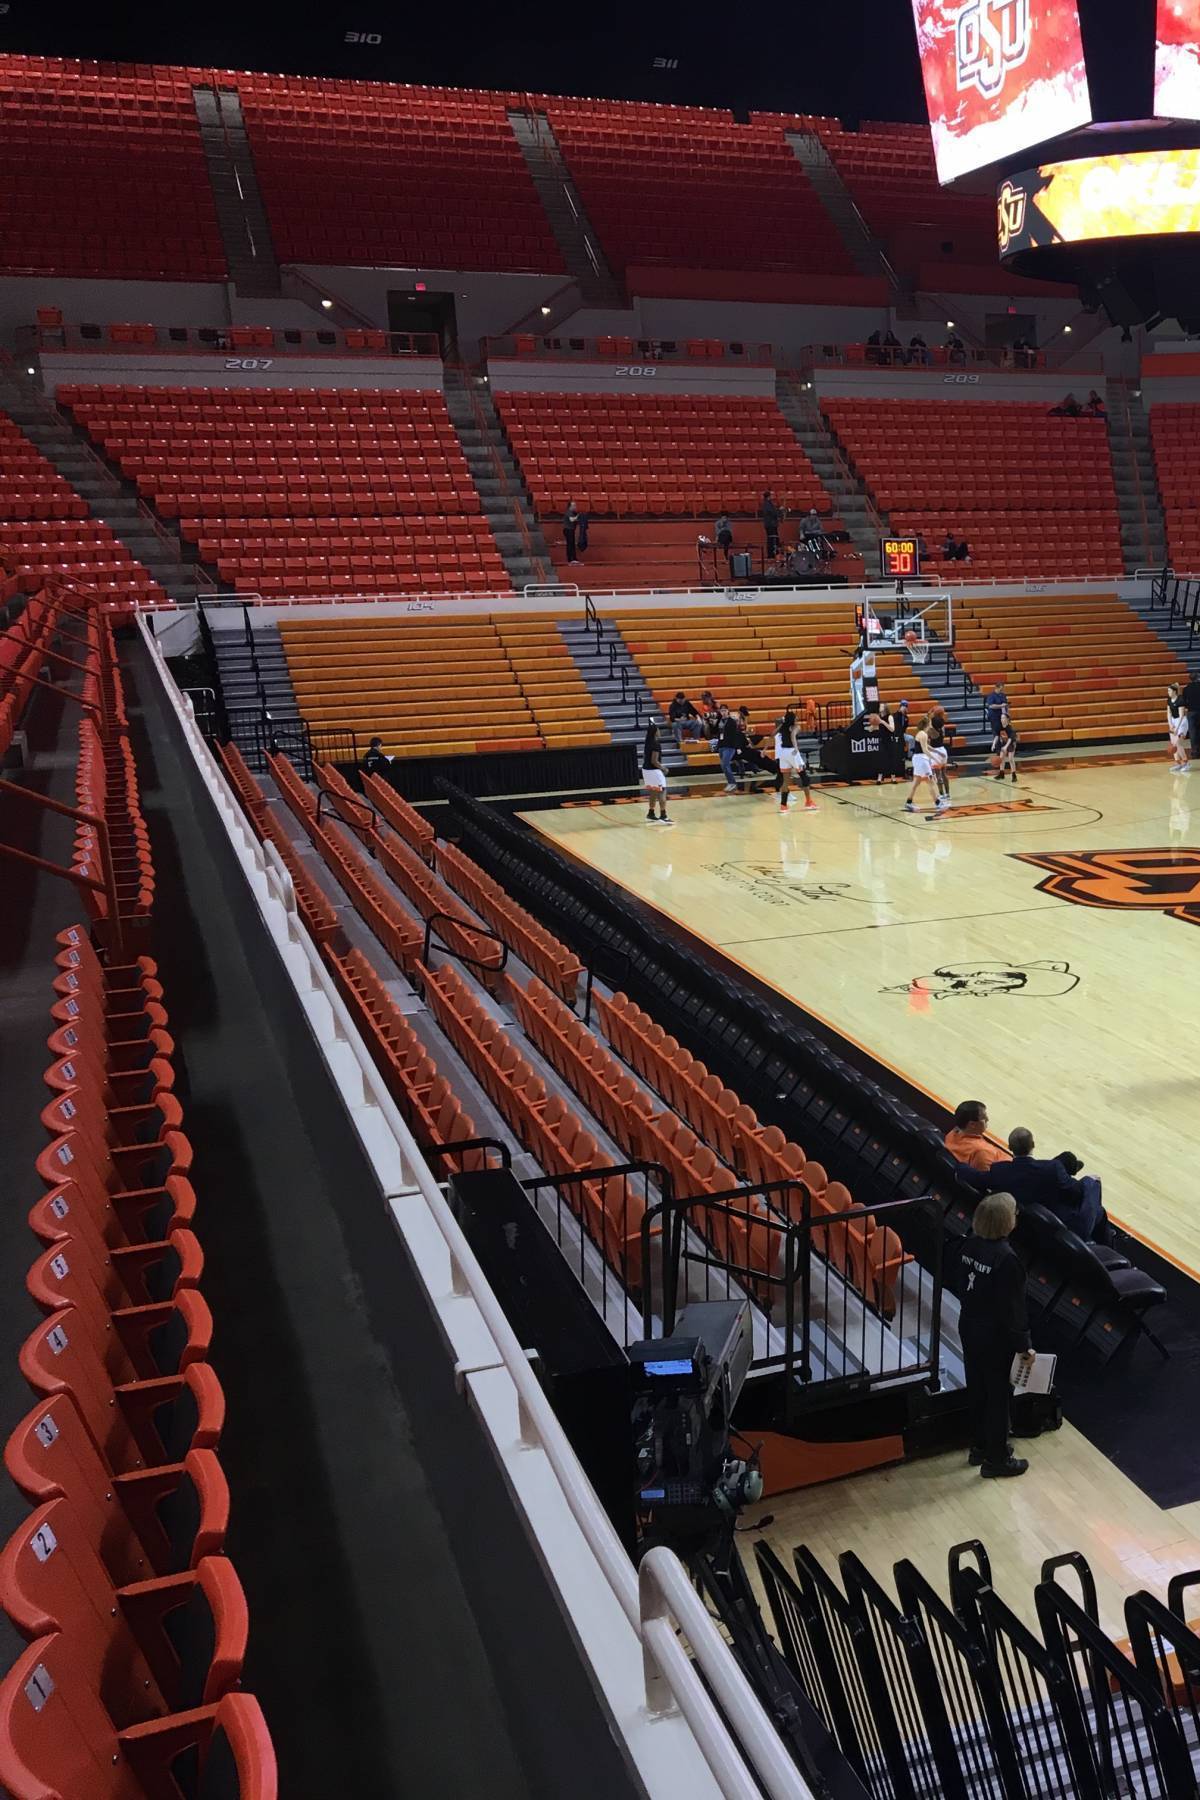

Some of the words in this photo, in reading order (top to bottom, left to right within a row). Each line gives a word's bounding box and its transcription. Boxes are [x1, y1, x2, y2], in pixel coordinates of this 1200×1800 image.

[344, 32, 382, 44] 310
[652, 57, 678, 69] 311
[224, 359, 272, 370] 207
[615, 366, 656, 376] 208
[943, 374, 979, 384] 209
[886, 542, 914, 553] 60:00
[890, 554, 911, 572] 30
[54, 1258, 65, 1276] 5
[52, 1334, 64, 1350] 4
[41, 1422, 53, 1441] 3
[37, 1532, 52, 1555] 2
[32, 1676, 46, 1698] 1
